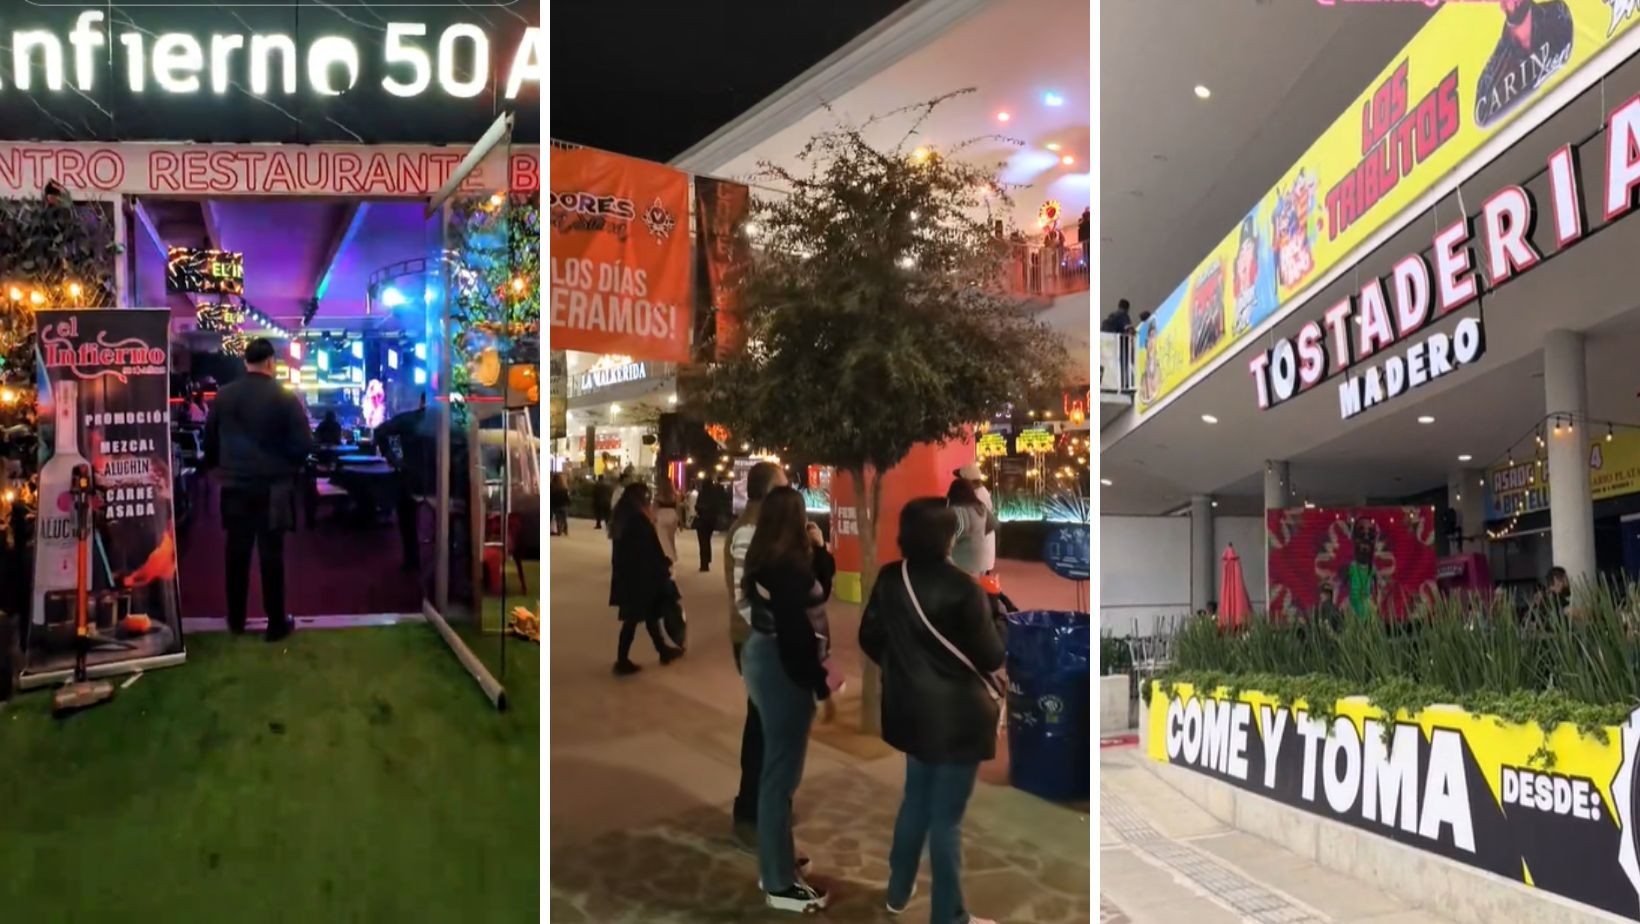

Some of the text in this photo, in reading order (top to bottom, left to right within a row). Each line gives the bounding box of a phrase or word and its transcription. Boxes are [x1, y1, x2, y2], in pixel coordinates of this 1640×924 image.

[0, 11, 360, 96] nfierno
[381, 21, 490, 98] 50
[1361, 56, 1409, 157] LOS
[1325, 65, 1460, 242] TRIBUTOS
[551, 256, 647, 298] LOS DÍAS
[1249, 94, 1640, 411] TOSTADERIA
[57, 316, 79, 337] el
[551, 288, 677, 340] ERAMOS!
[44, 341, 166, 368] Infierno
[1338, 317, 1481, 419] MADERO
[100, 439, 155, 453] MEZCAL
[104, 459, 149, 477] ALUCHIN
[106, 503, 156, 519] ASADA
[1166, 696, 1476, 854] COME Y TOMA
[1502, 768, 1602, 822] DESDE:
